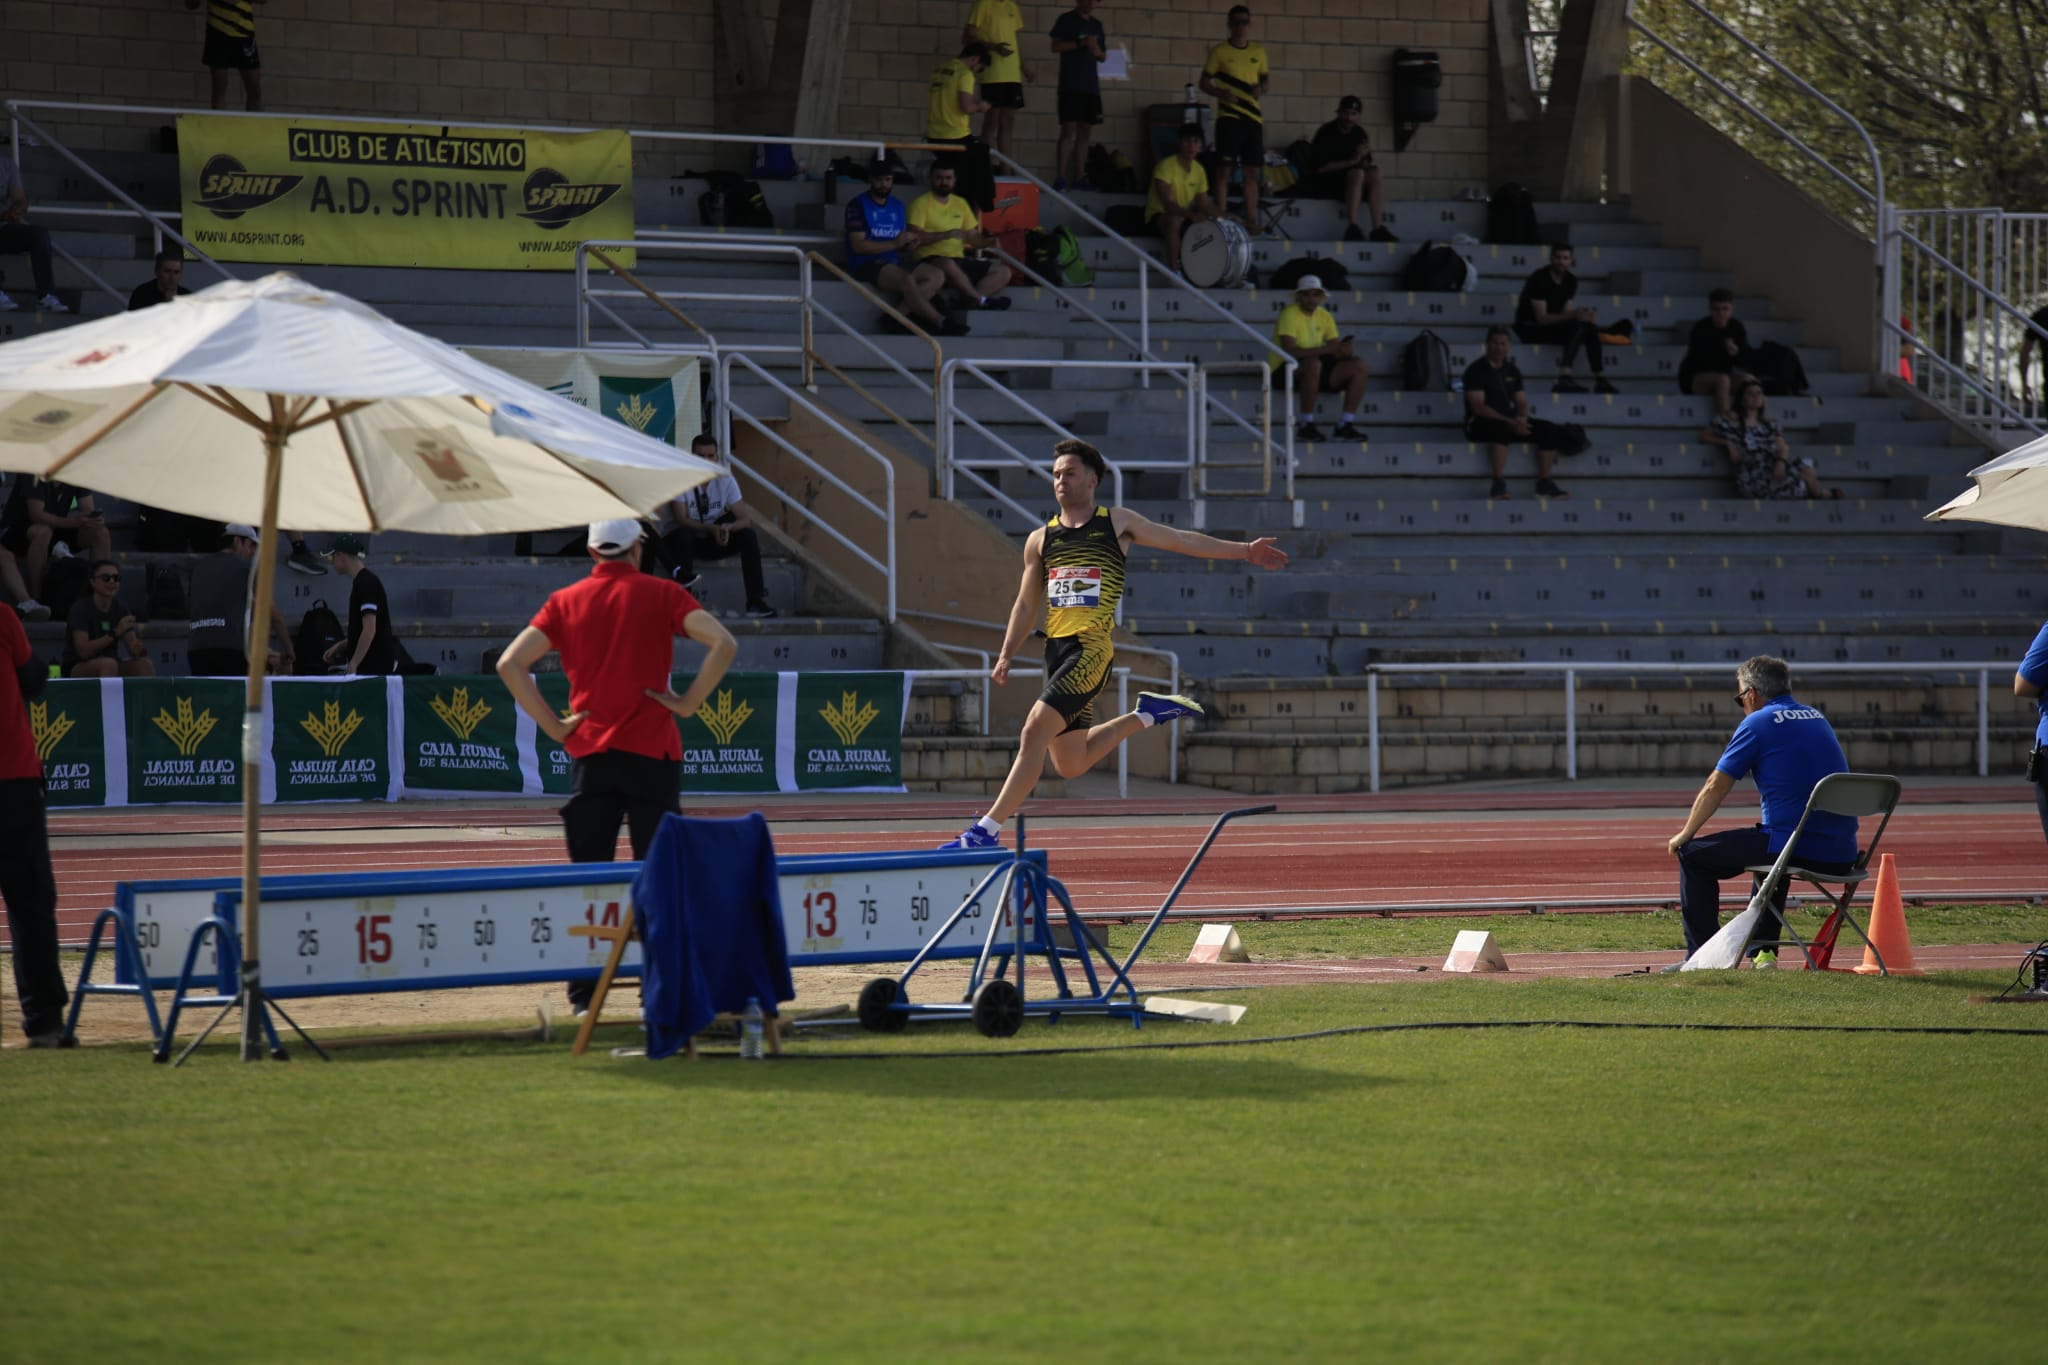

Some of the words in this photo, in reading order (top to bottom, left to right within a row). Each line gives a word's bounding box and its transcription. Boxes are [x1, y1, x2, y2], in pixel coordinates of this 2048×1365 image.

[293, 132, 350, 159] CLUB
[358, 136, 387, 161] DE
[395, 136, 524, 167] ATLETISMO
[204, 174, 283, 196] SPRINT
[310, 175, 381, 215] A.D.
[392, 178, 508, 219] SPRINT
[528, 186, 604, 207] SPRINT
[195, 230, 305, 246] WWW.ADSPRINT.ORG
[1055, 581, 1070, 594] 25
[419, 742, 457, 757] CAJA
[460, 743, 505, 760] RURAL
[550, 751, 569, 762] CA
[684, 750, 715, 762] CAJA
[719, 749, 763, 762] RURAL
[808, 750, 842, 762] CAJA
[845, 750, 891, 762] RURAL
[419, 757, 435, 768] DE
[440, 757, 509, 770] SALAMANCA
[552, 765, 566, 775] DE
[684, 764, 698, 774] DE
[702, 764, 764, 774] SALAMANCA
[807, 764, 822, 773] DE
[803, 892, 837, 938] 13
[859, 900, 877, 925] 75
[911, 896, 929, 921] 50
[137, 922, 160, 949] 50
[355, 915, 392, 964] 15
[417, 923, 437, 950] 75
[474, 919, 496, 946] 50
[531, 917, 551, 943] 25
[298, 929, 319, 957] 25
